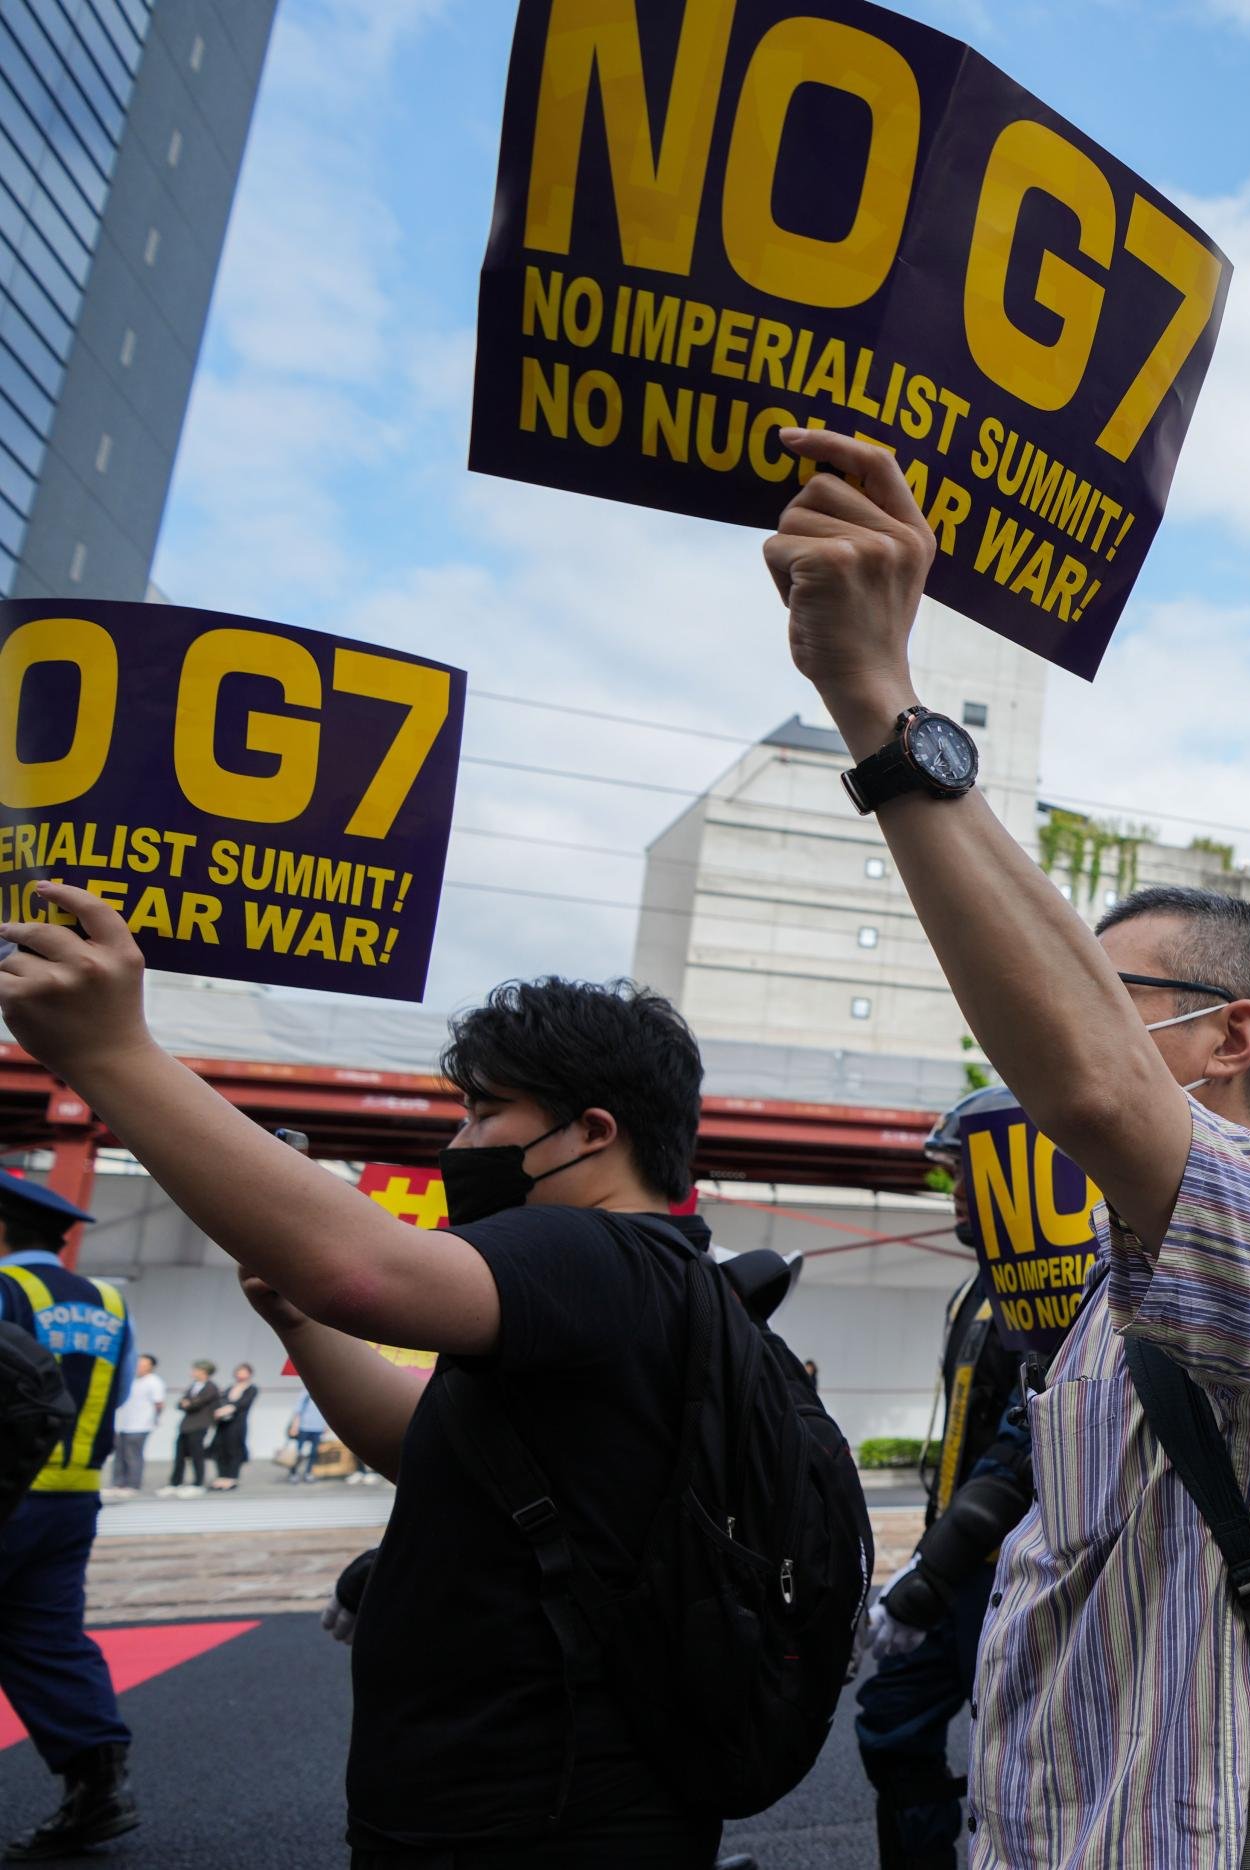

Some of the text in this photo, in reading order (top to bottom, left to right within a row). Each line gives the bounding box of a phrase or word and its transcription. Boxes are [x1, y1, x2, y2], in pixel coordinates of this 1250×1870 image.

[523, 0, 1223, 463] NO G7
[523, 266, 1137, 562] NO IMPERIALIST SUMMIT!
[519, 357, 622, 448] NO
[972, 506, 1102, 623] WAR!
[173, 628, 451, 840] G7
[208, 839, 414, 914] SUMMIT!
[244, 900, 400, 967] WAR!
[967, 1122, 1106, 1261] NO
[38, 1304, 121, 1336] POLICE
[991, 1263, 1018, 1294] NO
[1000, 1299, 1034, 1331] NO
